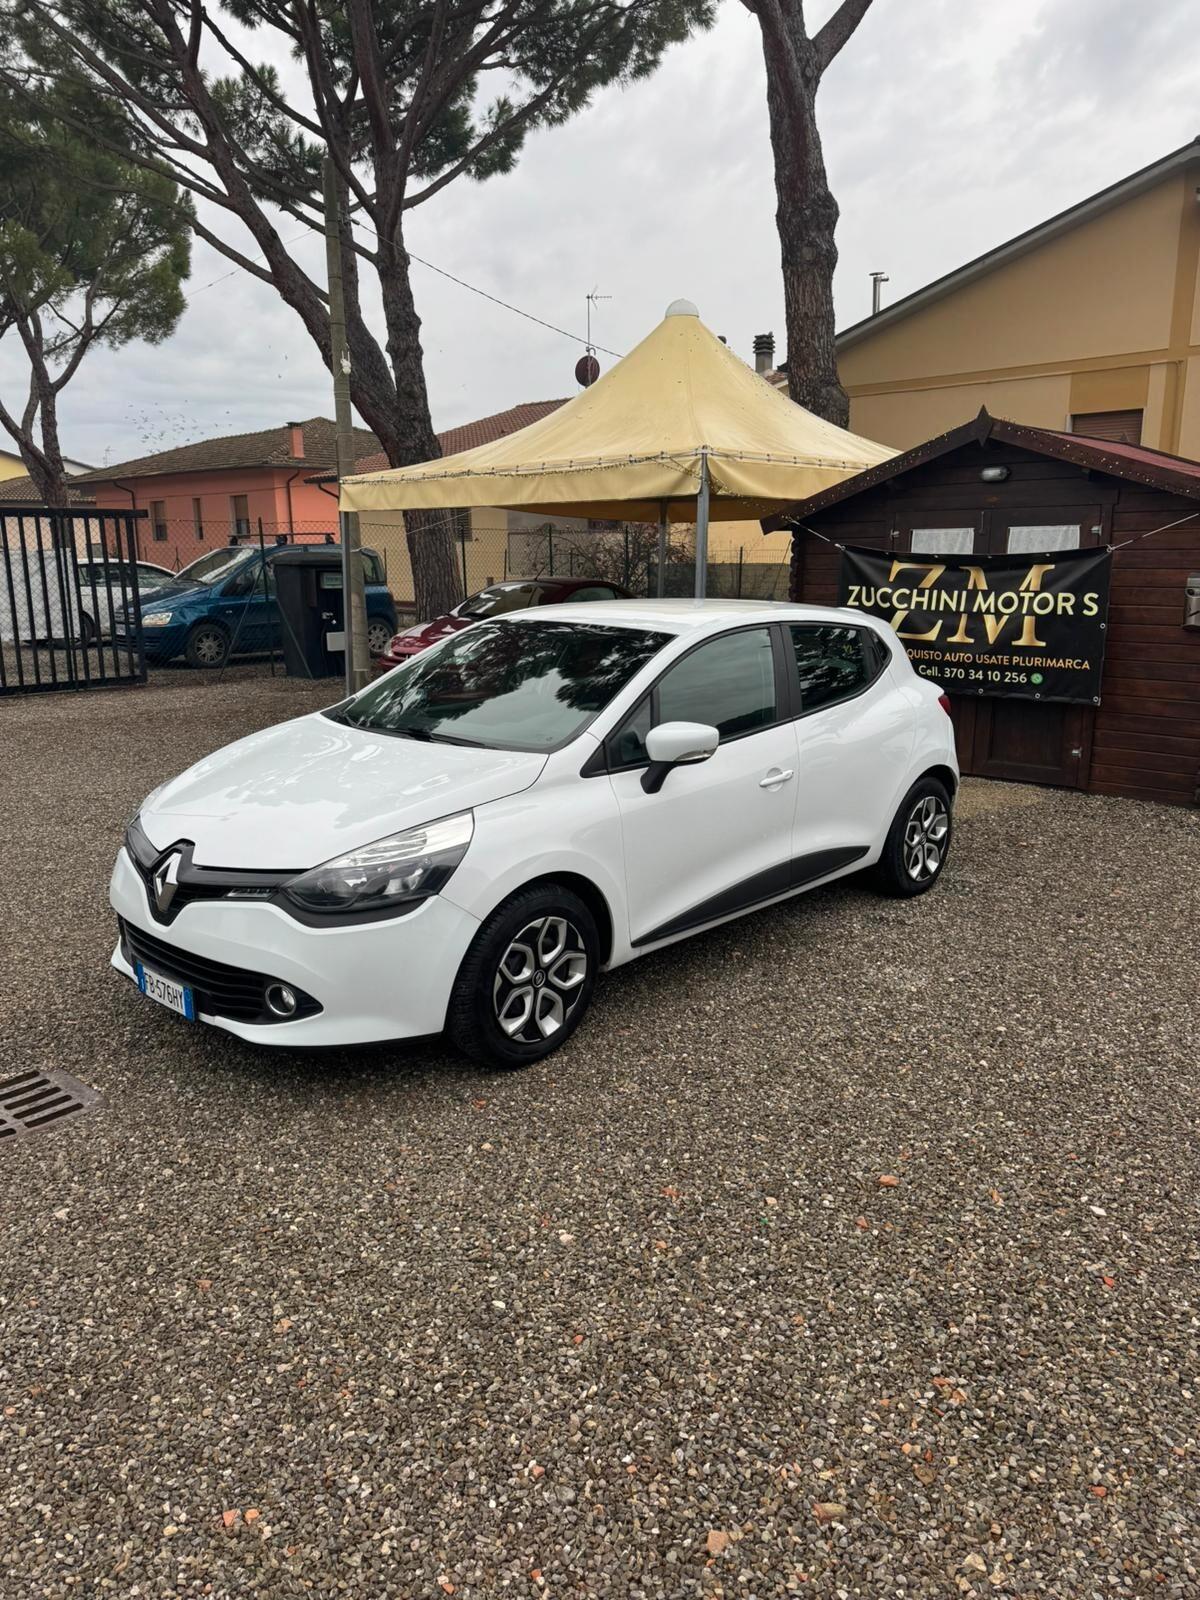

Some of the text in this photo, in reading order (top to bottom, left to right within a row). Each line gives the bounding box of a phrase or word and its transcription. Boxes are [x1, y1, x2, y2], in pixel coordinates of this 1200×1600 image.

[847, 585, 967, 612] ZUCCHINI
[907, 649, 1090, 670] QUISTO AUTO USATE PLURIMARCA
[919, 665, 1027, 683] Cell. 370 34 10 256
